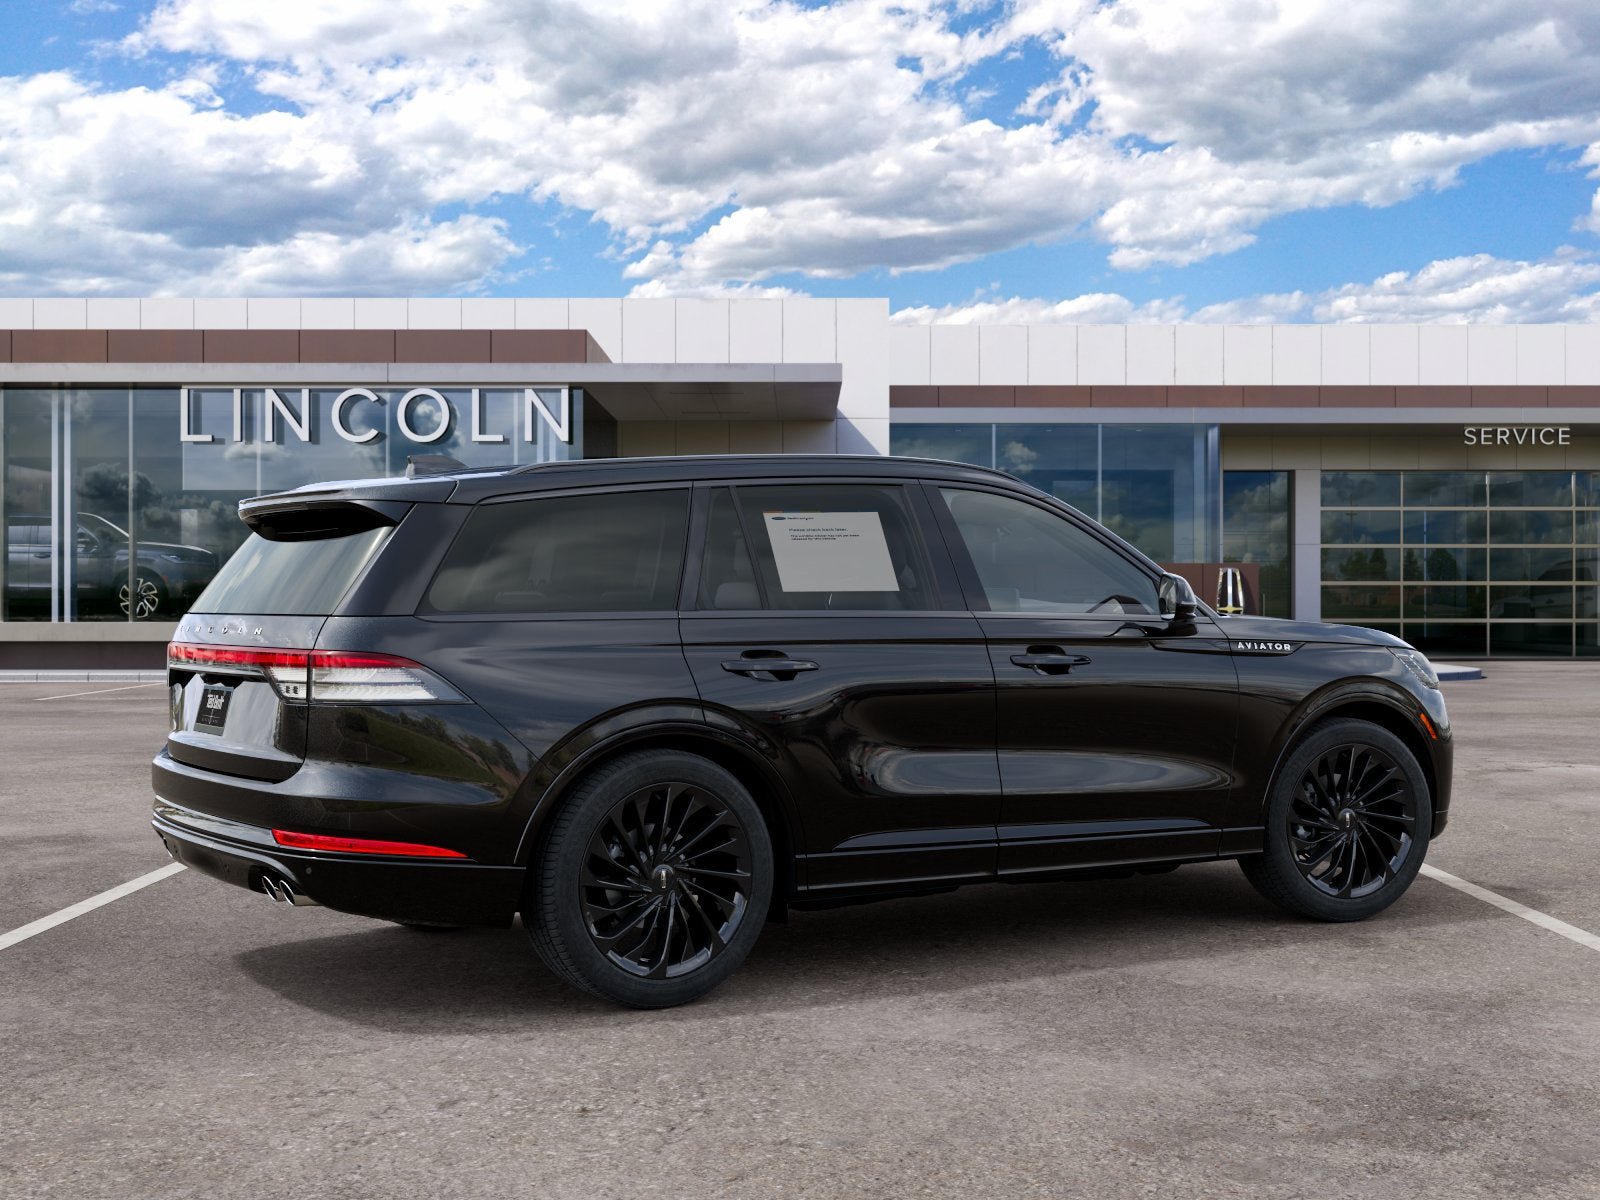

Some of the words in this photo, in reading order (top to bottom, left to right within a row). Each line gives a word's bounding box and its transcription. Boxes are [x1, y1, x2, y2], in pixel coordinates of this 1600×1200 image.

[179, 388, 570, 444] LINCOLN
[1463, 427, 1571, 445] SERVICE
[1237, 641, 1291, 651] AVIATOR
